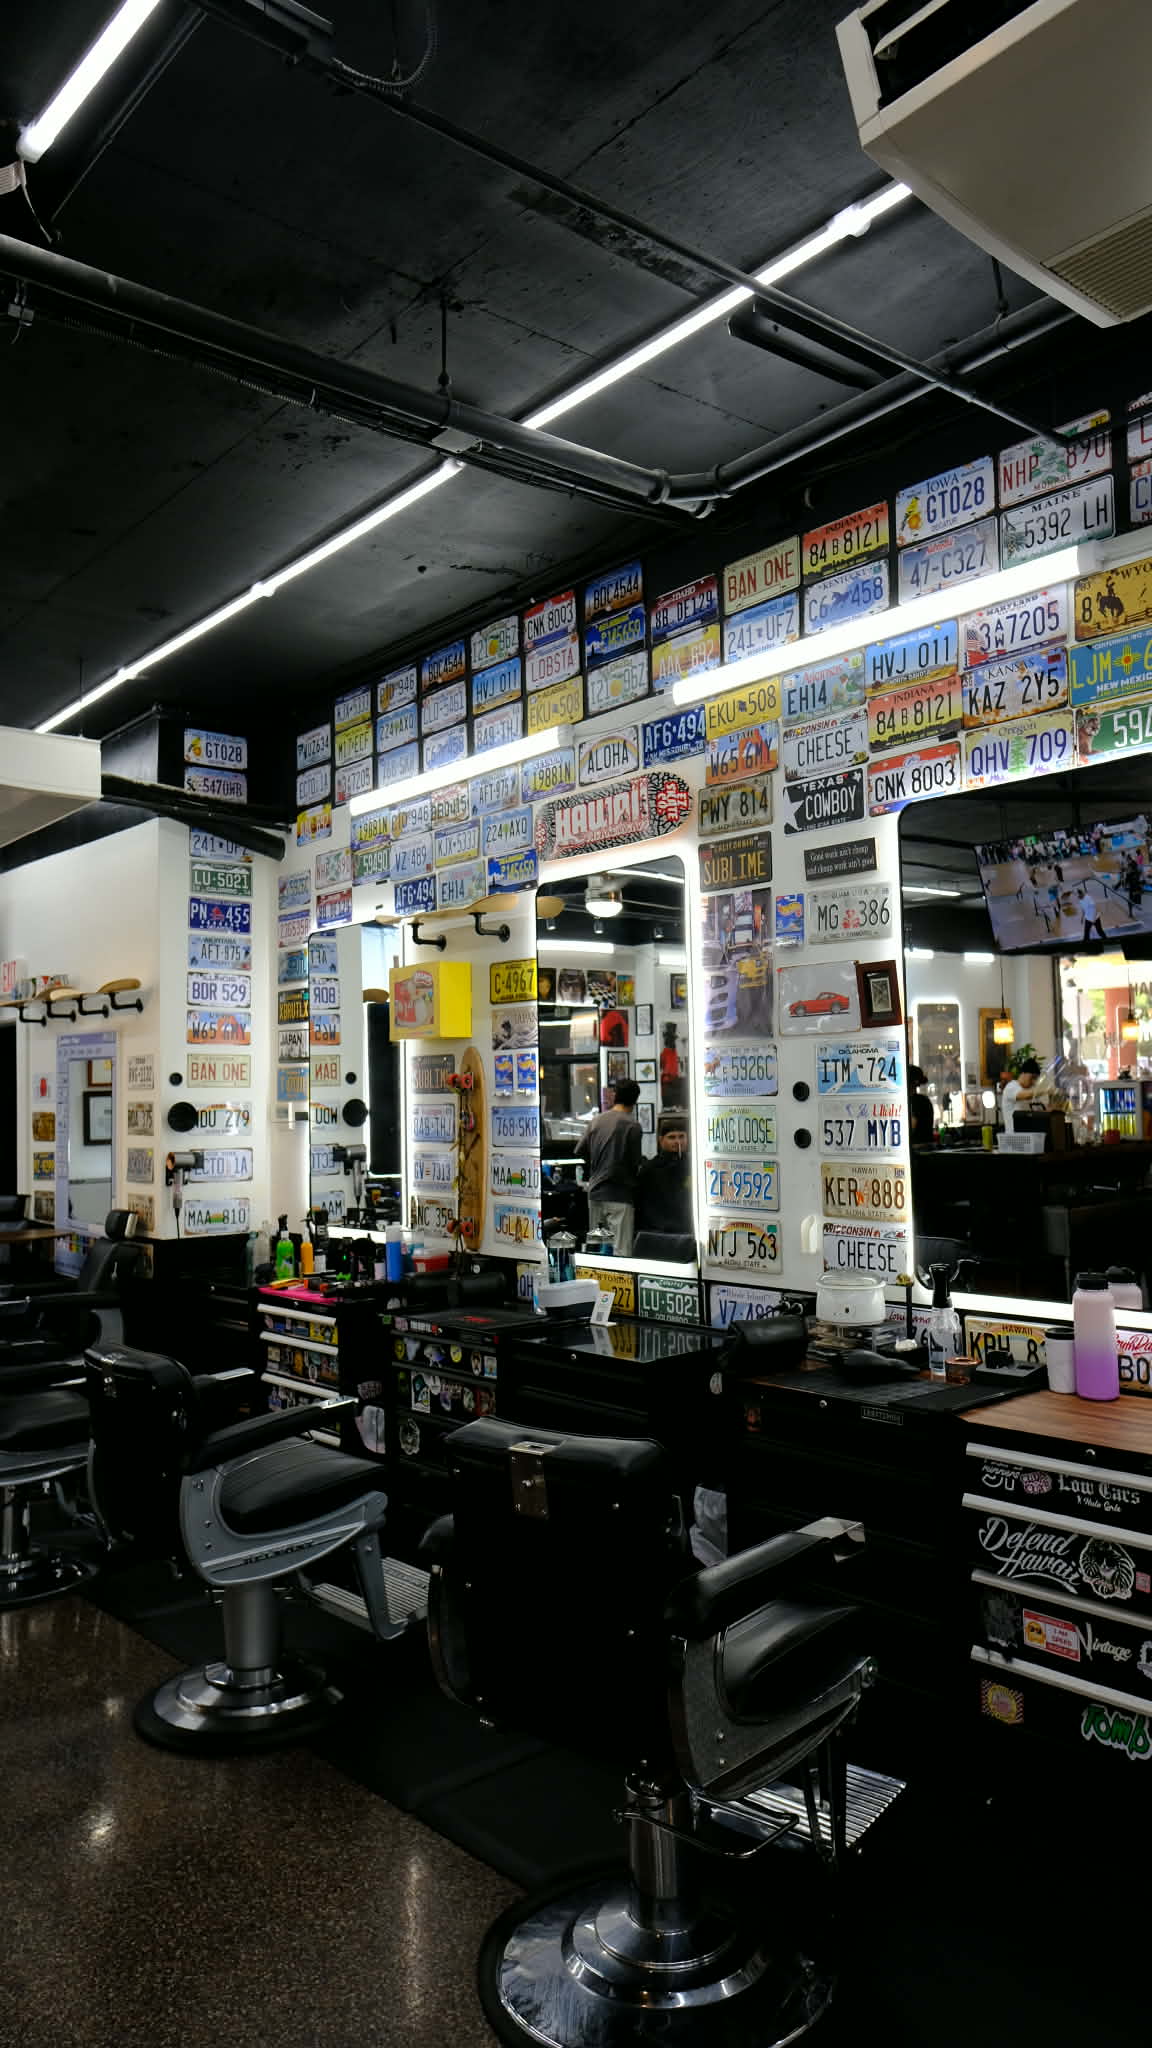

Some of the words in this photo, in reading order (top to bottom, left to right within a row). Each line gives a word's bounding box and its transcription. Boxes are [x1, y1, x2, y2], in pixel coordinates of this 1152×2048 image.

[1002, 454, 1039, 493] NHP
[1031, 490, 1082, 513] MAINE
[825, 514, 864, 534] INDIANA
[1024, 507, 1071, 549] 5392
[1083, 493, 1108, 531] LH
[809, 539, 828, 567] 84
[843, 517, 880, 555] 8121
[727, 565, 758, 602] BAN
[763, 550, 796, 586] ONE
[910, 543, 988, 588] 47-C327
[527, 616, 545, 641] CNK
[765, 609, 795, 646] UFZ
[872, 648, 906, 682] HVJ
[918, 635, 950, 669] 011
[1072, 650, 1113, 690] LJM
[787, 679, 828, 716] EH14
[893, 685, 935, 704] INDIANA
[968, 681, 1007, 717] KAZ
[1021, 667, 1060, 705] 2Y5
[708, 698, 737, 729] EKU
[748, 684, 778, 716] 508
[876, 708, 896, 736] 84
[913, 691, 952, 726] 8121
[205, 741, 243, 763] GT028
[587, 739, 629, 776] ALOHA
[797, 727, 853, 767] CHEESE
[971, 739, 1009, 777] QHV
[1026, 728, 1067, 766] 709
[710, 747, 739, 778] W65
[802, 774, 845, 793] TEXAS
[874, 771, 907, 803] CNK
[700, 793, 731, 828] PWY
[739, 785, 769, 817] 814
[804, 785, 857, 821] COWBOY
[192, 835, 215, 850] 241
[702, 850, 768, 887] SUBLIME
[190, 902, 208, 921] PN
[225, 906, 250, 926] 455
[817, 903, 839, 934] MG
[858, 897, 891, 928] 386
[221, 983, 247, 1002] 529
[191, 1023, 217, 1041] W65
[838, 1047, 879, 1055] OKLAHOMA
[191, 1062, 217, 1081] BAN
[222, 1062, 248, 1081] ONE
[730, 1055, 774, 1082] 5926C
[821, 1058, 851, 1084] ITM
[224, 1109, 250, 1129] 279
[707, 1117, 737, 1145] HANG
[738, 1117, 774, 1145] LOOSE
[823, 1119, 855, 1147] 537
[867, 1119, 902, 1147] MYB
[233, 1156, 249, 1175] 1A
[493, 1168, 513, 1186] MAA
[520, 1168, 539, 1189] 810
[852, 1166, 878, 1176] HAWAII
[825, 1177, 859, 1207] KER
[871, 1178, 905, 1209] 888
[187, 1207, 212, 1226] MAA
[222, 1207, 247, 1225] 810
[866, 1209, 887, 1218] STATE
[823, 1223, 875, 1237] WISCONSIN
[746, 1231, 778, 1260] 563
[836, 1239, 898, 1274] CHEESE
[611, 1286, 632, 1308] 227
[1001, 1324, 1034, 1336] HAWAII
[1057, 1474, 1094, 1496] Low
[978, 1516, 1079, 1556] Defend
[1075, 1621, 1133, 1662] Vintage
